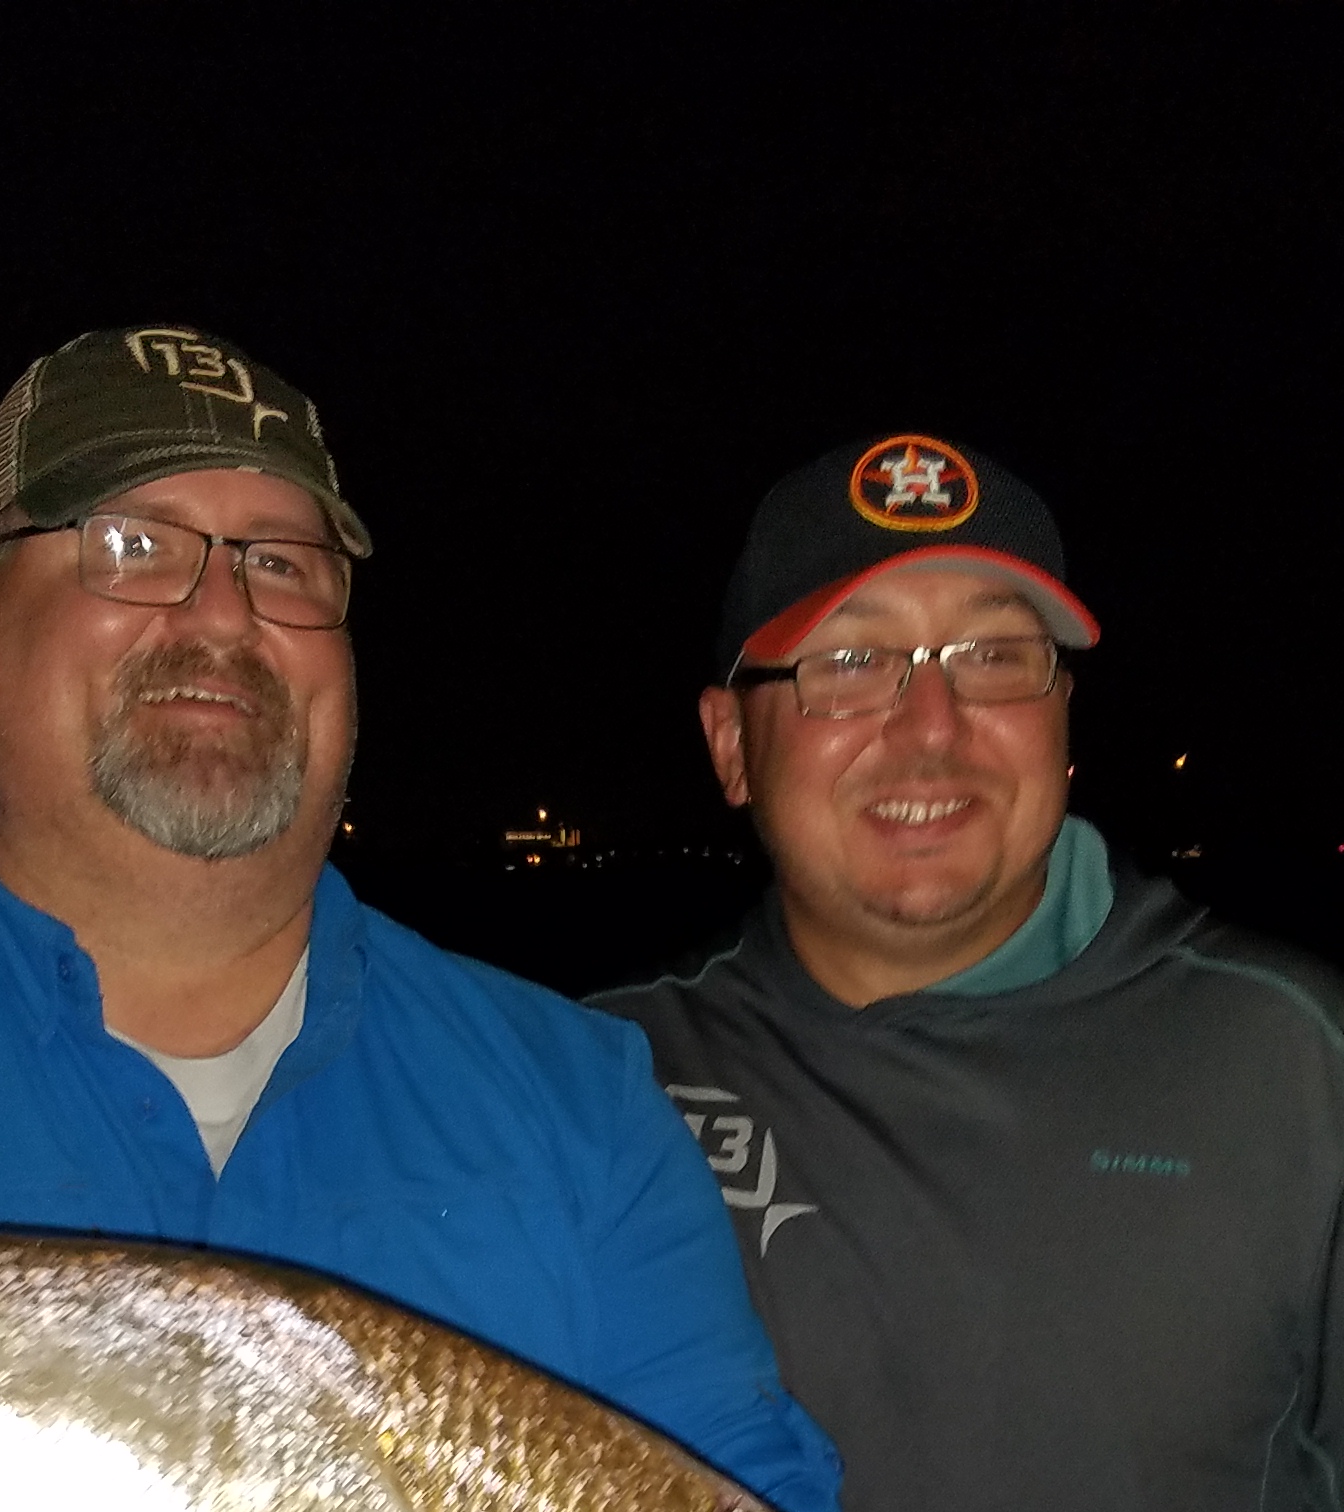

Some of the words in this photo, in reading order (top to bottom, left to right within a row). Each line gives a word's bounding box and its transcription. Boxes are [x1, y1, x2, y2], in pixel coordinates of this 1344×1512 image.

[150, 341, 226, 377] 13
[880, 457, 952, 507] H
[1090, 1148, 1192, 1177] SIMMS
